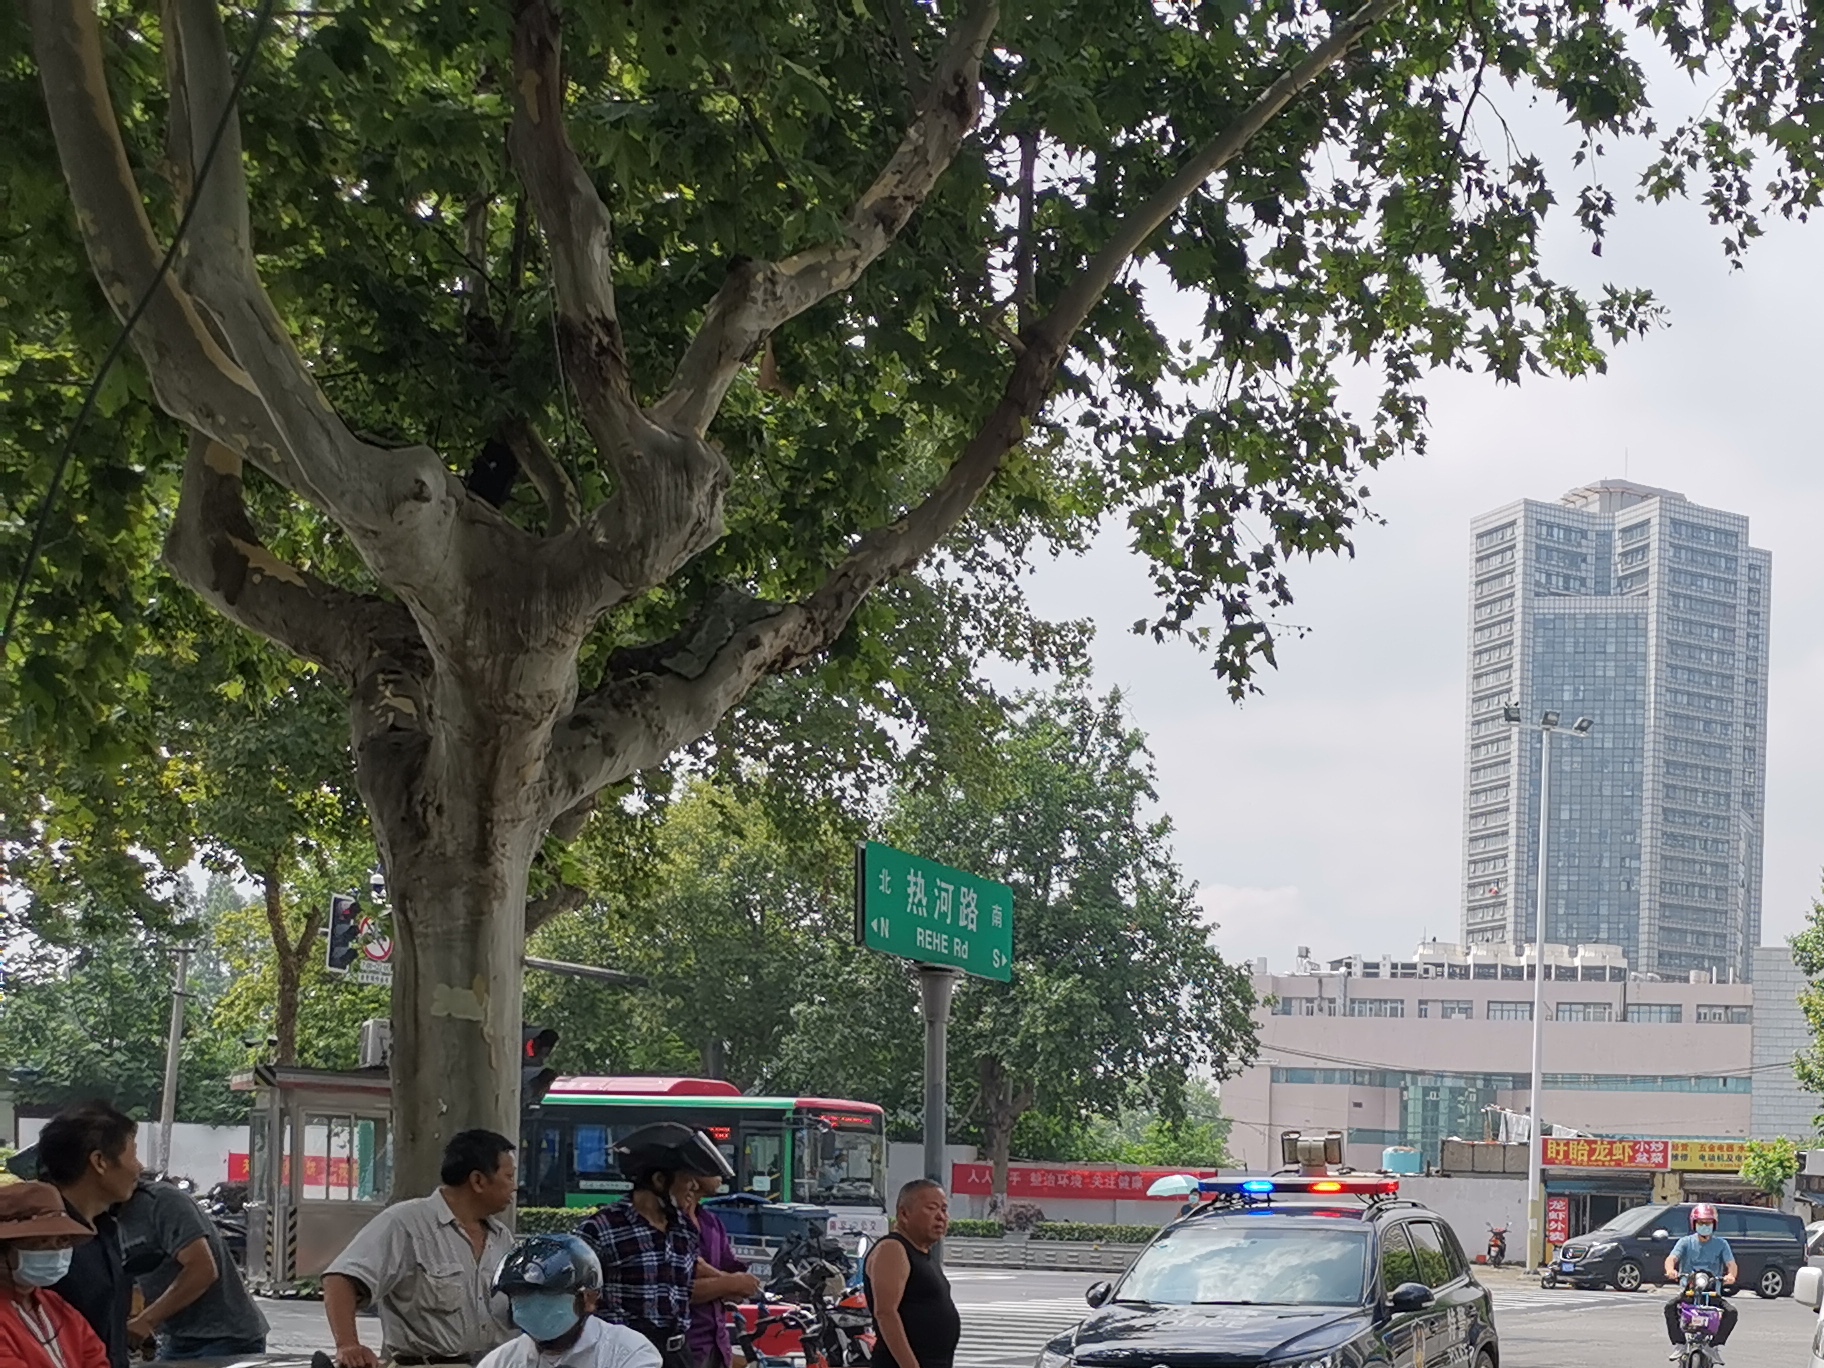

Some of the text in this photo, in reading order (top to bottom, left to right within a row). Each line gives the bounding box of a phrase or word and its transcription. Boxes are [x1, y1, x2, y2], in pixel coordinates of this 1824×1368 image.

[878, 867, 1003, 932] 北 热河路 南
[880, 917, 1001, 968] N REHE Rd S
[1547, 1139, 1634, 1162] 盱眙龙虾
[968, 1169, 1021, 1187] 人人手
